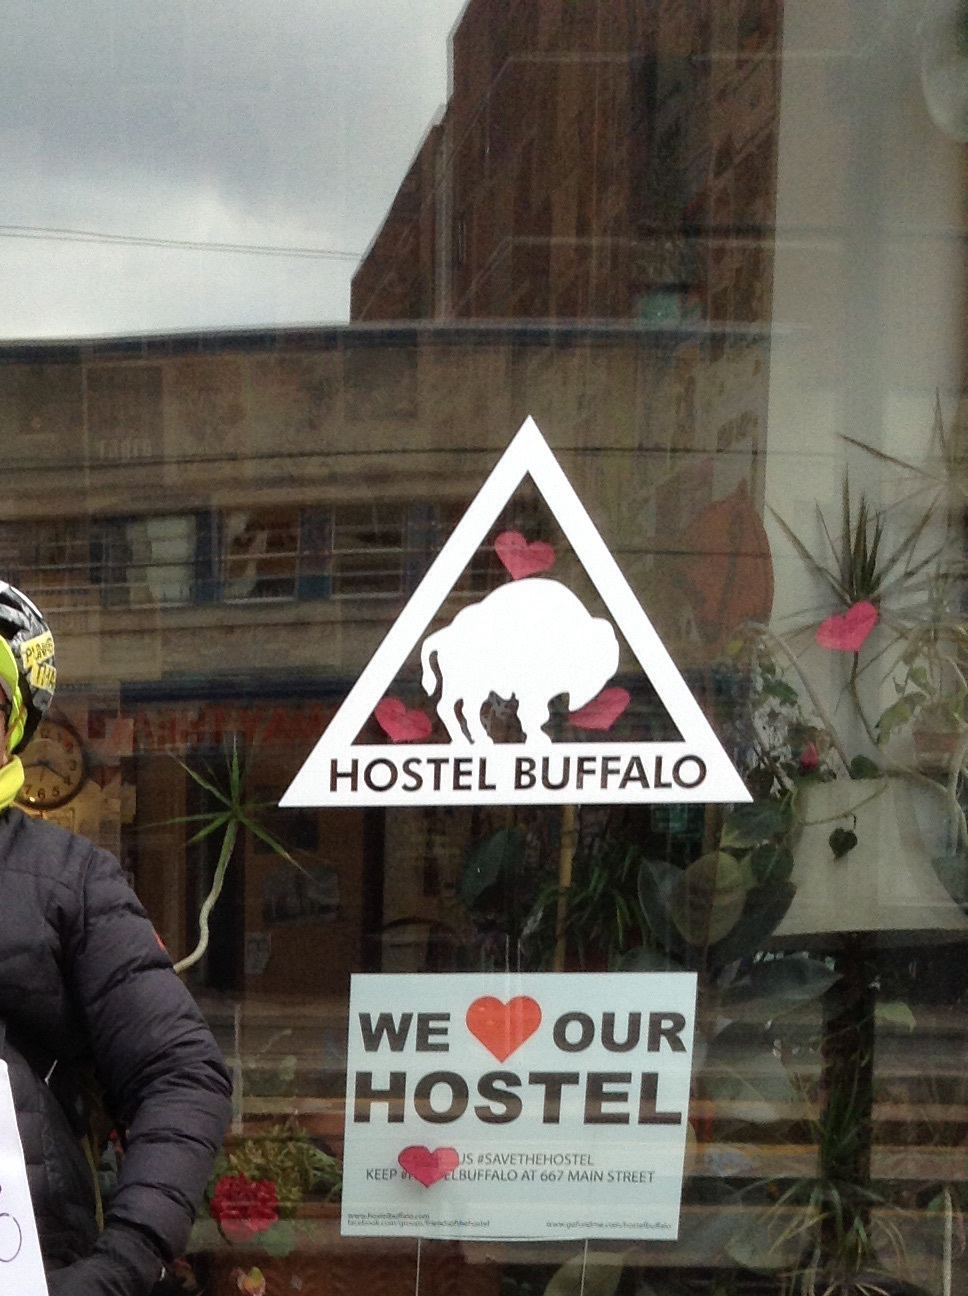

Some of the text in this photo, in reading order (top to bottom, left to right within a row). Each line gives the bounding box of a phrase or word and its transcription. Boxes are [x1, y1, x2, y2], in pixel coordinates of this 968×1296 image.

[329, 753, 708, 793] HOSTEL BUFFALO
[358, 1011, 688, 1053] WE OUR
[353, 1071, 682, 1125] HOSTEL
[366, 1168, 397, 1181] KEEP
[521, 1169, 536, 1182] AT
[540, 1169, 564, 1182] 667
[568, 1169, 604, 1182] MAIN
[608, 1169, 655, 1183] STREET
[477, 1153, 595, 1167] #SAVETHEHOSTEL
